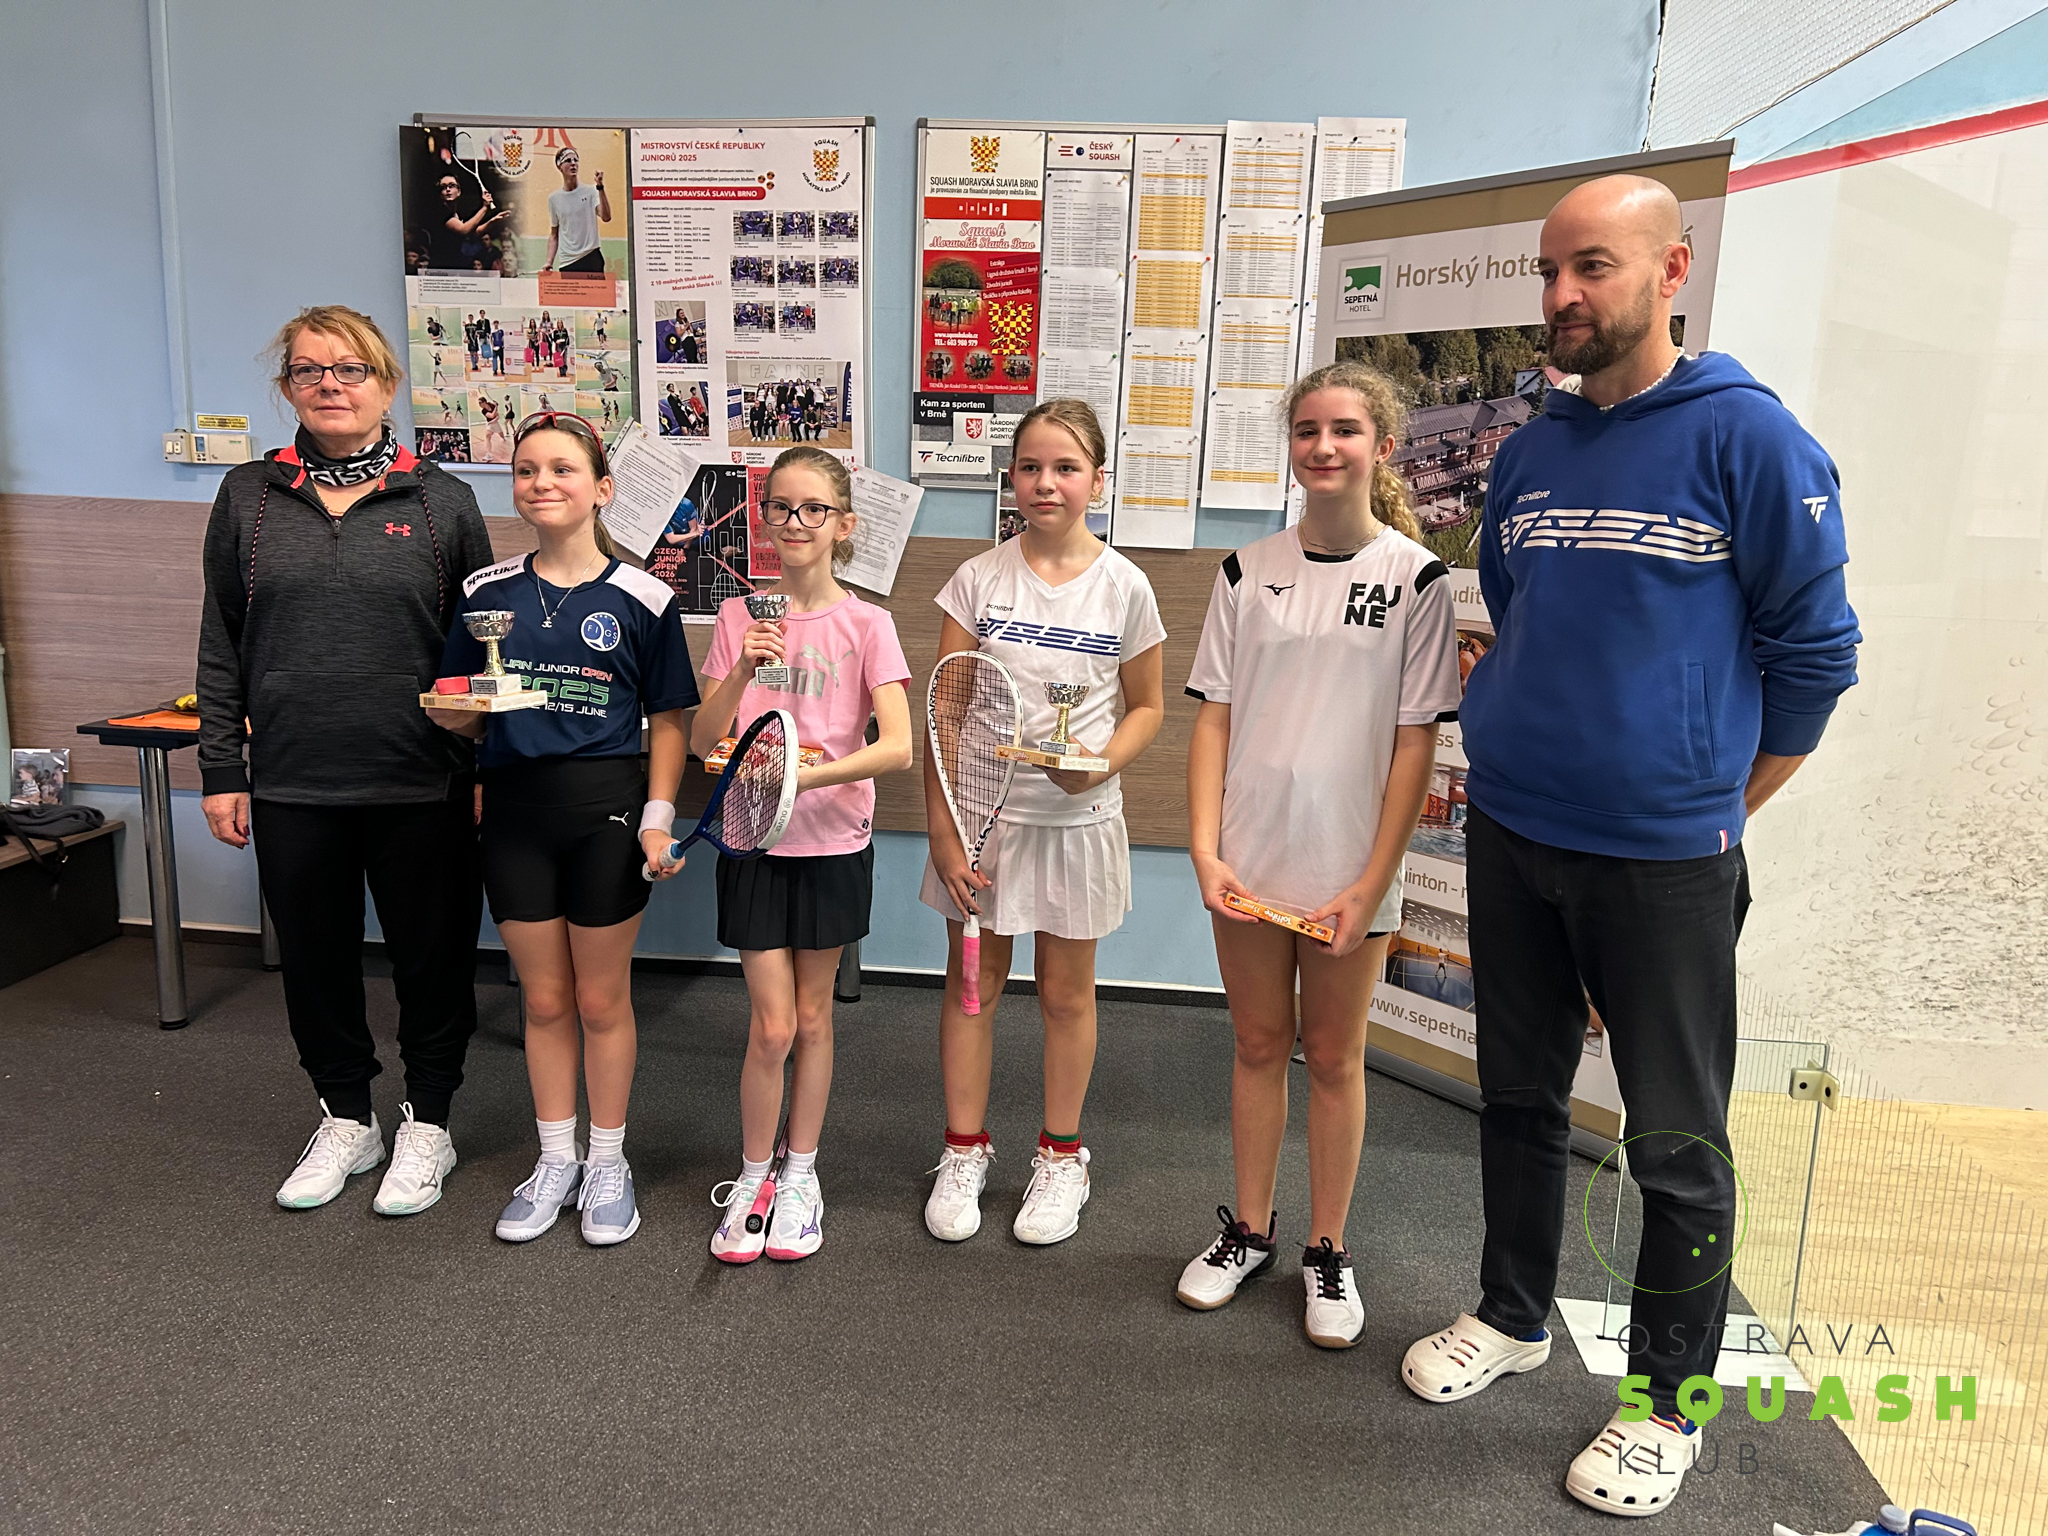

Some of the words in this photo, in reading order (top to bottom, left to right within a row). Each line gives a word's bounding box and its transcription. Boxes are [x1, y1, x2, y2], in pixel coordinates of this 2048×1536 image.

[640, 141, 693, 150] MISTROVSTVÍ
[695, 141, 721, 150] ČESKÉ
[723, 142, 766, 150] REPUBLIKY
[814, 139, 839, 147] SQUASH
[1089, 141, 1114, 151] ČESKÝ
[640, 152, 677, 162] JUNIORŮ
[678, 154, 698, 162] 2025
[1089, 153, 1120, 161] SQUASH
[802, 172, 824, 192] MORAVSKÁ
[930, 176, 957, 186] SQUASH
[959, 176, 995, 187] MORAVSKÁ
[996, 178, 1018, 188] SLAVIA
[1020, 179, 1039, 188] BRNO
[671, 189, 711, 197] MORAVSKÁ
[989, 188, 1009, 196] podpory
[959, 221, 1006, 239] Squash
[929, 235, 978, 249] Moravská
[978, 236, 1010, 249] Slavia
[1011, 237, 1036, 250] Brno
[1396, 255, 1480, 289] Horský
[1485, 253, 1541, 280] hote
[1344, 293, 1378, 304] SEPETNÁ
[1349, 305, 1371, 313] HOTEL
[750, 364, 826, 379] FAJNE
[920, 399, 939, 408] Kam
[952, 400, 986, 410] sportem
[927, 410, 947, 418] Brně
[935, 453, 985, 463] Tecnifibre
[1516, 489, 1551, 505] Tecnifibre
[654, 547, 685, 555] CZECH
[654, 555, 687, 563] JUNIOR
[654, 563, 678, 571] OPEN
[761, 562, 782, 571] ZÁBAV
[466, 563, 519, 588] sportika
[654, 570, 676, 578] 2026
[1347, 582, 1403, 609] FAJ
[1343, 604, 1387, 629] NE
[534, 664, 580, 675] JUNIOR
[581, 667, 613, 683] OPEN
[520, 675, 610, 706] 2025
[545, 702, 574, 713] 12/15
[576, 704, 607, 718] JUNE
